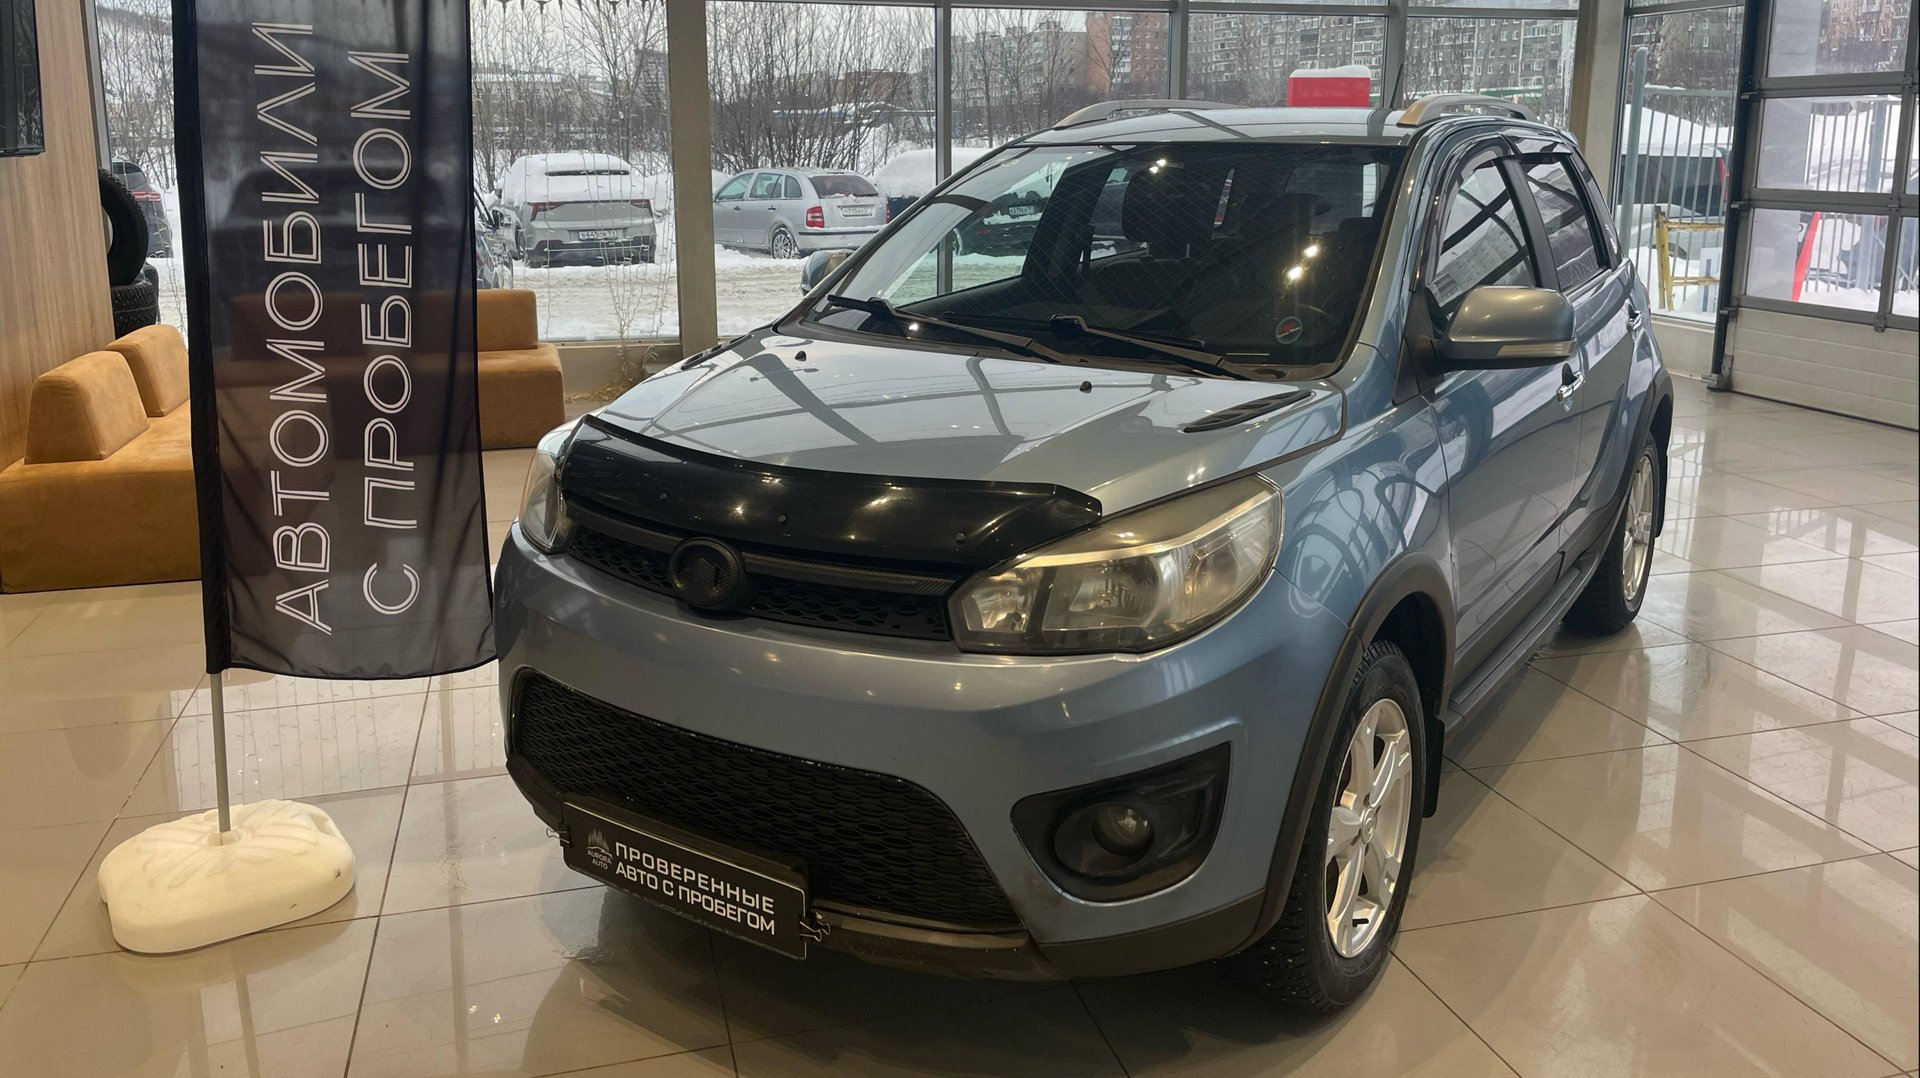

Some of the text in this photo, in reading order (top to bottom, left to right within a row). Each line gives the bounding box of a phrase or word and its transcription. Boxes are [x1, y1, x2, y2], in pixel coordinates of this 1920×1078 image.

[251, 22, 332, 636] АВТОМОБИЛИ
[347, 50, 420, 615] С ПРОБЕГОМ
[587, 849, 613, 865] AURORA
[592, 858, 609, 870] AUTO
[615, 841, 775, 915] ПРОВЕРЕННЫЕ
[615, 862, 775, 936] АВТО С ПРОБЕГОМ
